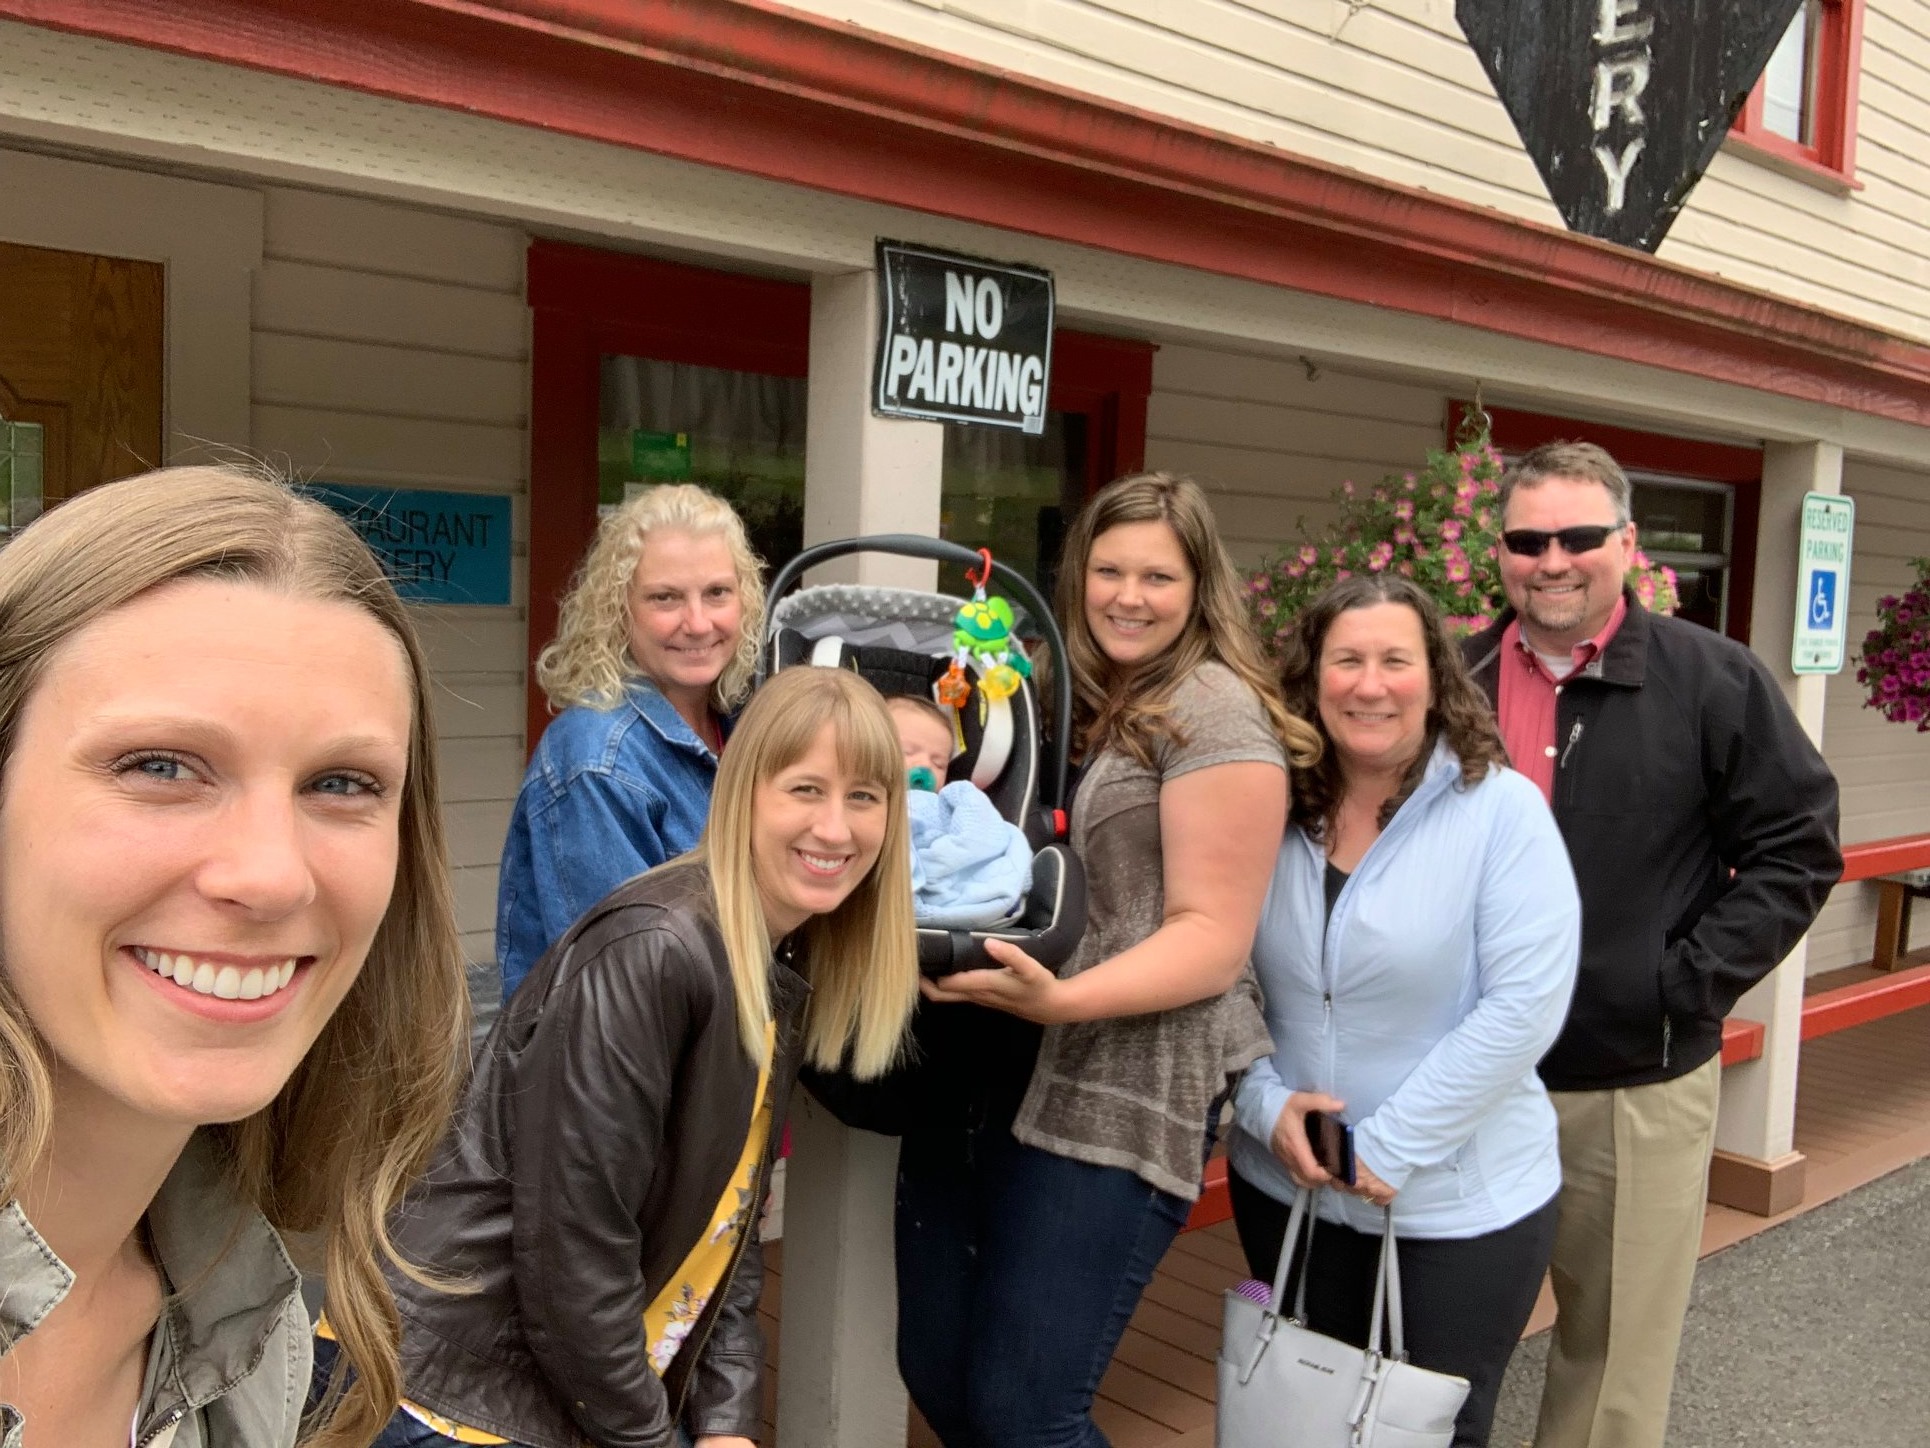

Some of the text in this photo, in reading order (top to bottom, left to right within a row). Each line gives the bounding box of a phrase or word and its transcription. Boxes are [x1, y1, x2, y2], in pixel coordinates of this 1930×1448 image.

[945, 270, 1004, 340] NO
[886, 333, 1044, 416] PARKING
[1806, 508, 1848, 532] RESERVED
[384, 547, 456, 585] ERY
[1806, 539, 1844, 563] PARKING
